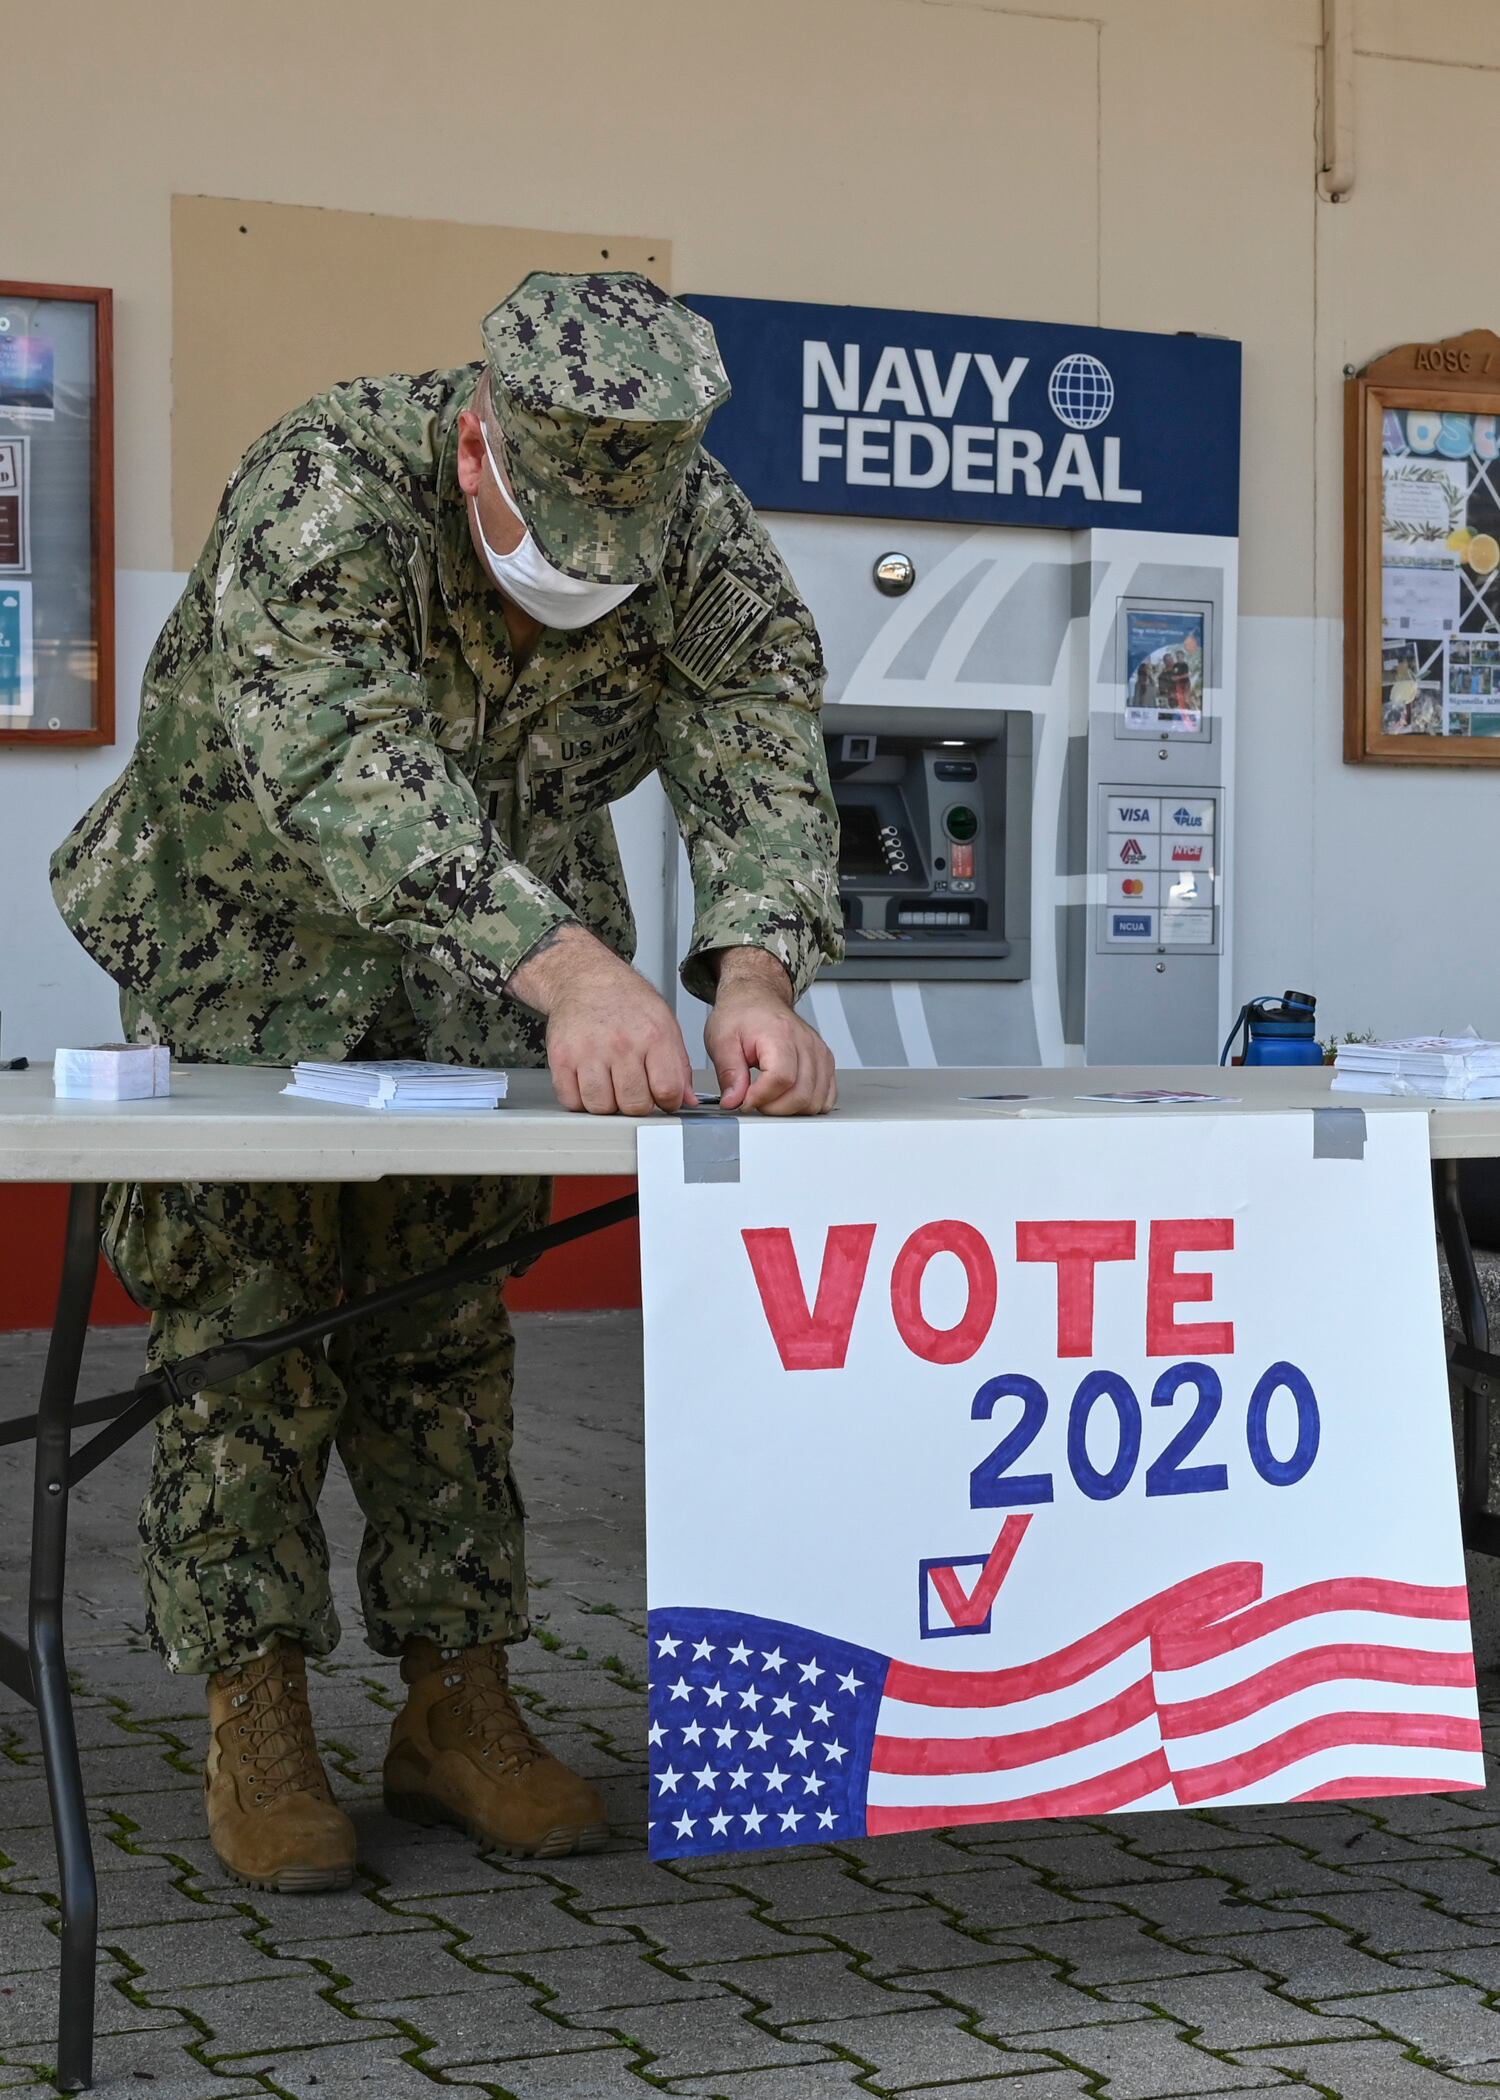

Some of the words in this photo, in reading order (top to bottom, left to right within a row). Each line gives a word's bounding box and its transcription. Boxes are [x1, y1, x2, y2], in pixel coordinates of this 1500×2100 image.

[1414, 348, 1473, 373] AOSC
[803, 340, 1030, 423] NAVY
[802, 414, 1142, 503] FEDERAL
[561, 740, 596, 761] U.S.
[1118, 808, 1150, 822] VISA
[1180, 816, 1203, 827] PLUS
[1119, 921, 1145, 932] NCUA
[741, 1219, 1234, 1371] VOTE
[970, 1361, 1321, 1510] 2020
